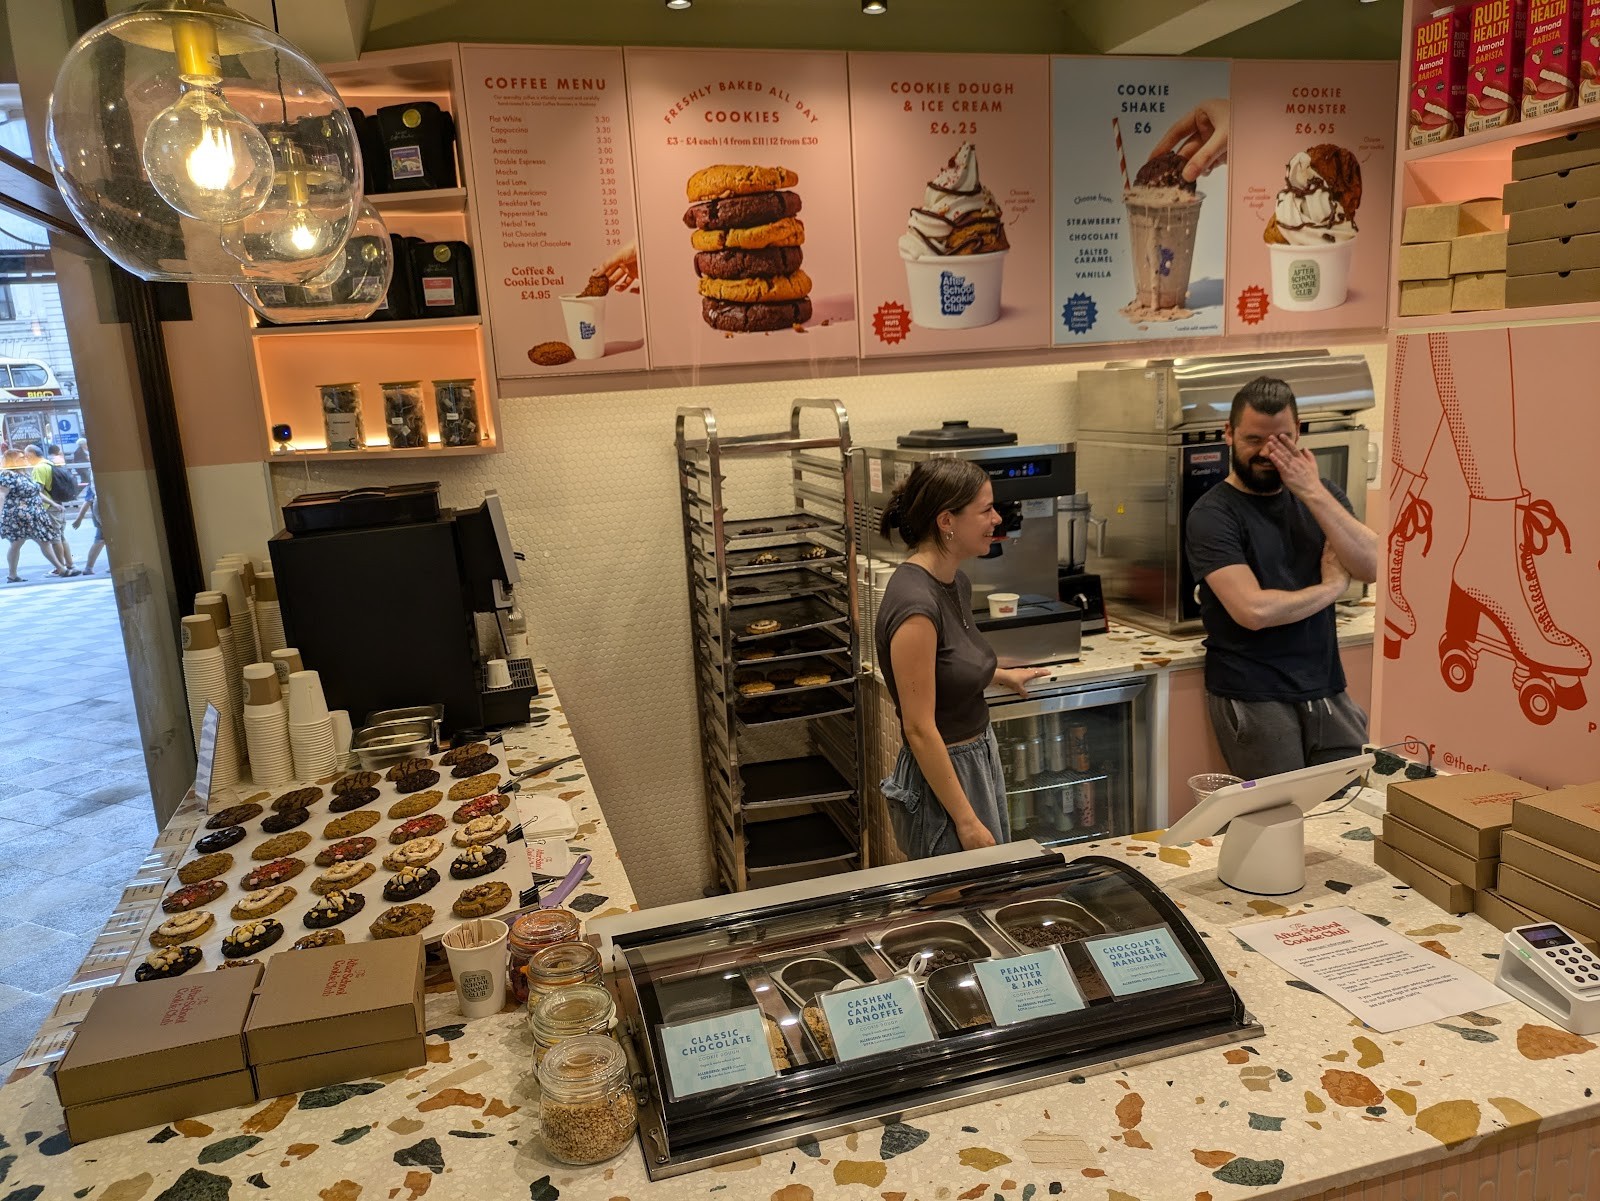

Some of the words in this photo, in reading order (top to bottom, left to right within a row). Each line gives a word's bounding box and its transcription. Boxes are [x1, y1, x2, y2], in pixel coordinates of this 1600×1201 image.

[1474, 0, 1510, 28] RUDE
[1531, 0, 1566, 24] HEALTH
[1417, 18, 1448, 46] RUDE
[1474, 19, 1509, 43] HEALTH
[1533, 20, 1562, 35] Almond
[1532, 31, 1560, 46] BARISTA
[1416, 40, 1448, 61] HEALTH
[1477, 38, 1504, 54] Almond
[1475, 49, 1503, 64] BARISTA
[1419, 58, 1443, 71] Almond
[1418, 68, 1442, 82] BARISTA
[485, 78, 547, 89] COFFEE
[558, 79, 606, 90] MENU
[891, 82, 950, 94] COOKIE
[958, 83, 1014, 94] DOUGH
[1118, 85, 1169, 96] COOKIE
[1292, 88, 1342, 98] COOKIE
[664, 85, 712, 124] FRESHLY
[719, 80, 762, 92] BAKED
[769, 87, 790, 103] ALL
[796, 101, 818, 124] DAY
[904, 101, 912, 112] &
[922, 101, 944, 112] ICE
[952, 101, 1002, 112] CREAM
[1122, 102, 1166, 112] SHAKE
[1286, 104, 1346, 114] MONSTER
[705, 111, 780, 123] COOKIES
[931, 122, 977, 134] £6.25
[1135, 122, 1151, 134] £6
[1296, 123, 1335, 134] £6.95
[667, 137, 678, 145] £3
[686, 137, 697, 145] £4
[802, 137, 818, 145] £30
[1074, 195, 1097, 204] Choose
[512, 267, 544, 275] Coffee
[547, 266, 554, 275] &
[504, 276, 541, 286] Cookie
[542, 276, 564, 285] Deal
[943, 276, 965, 286] After
[943, 283, 974, 294] School
[521, 291, 550, 299] £4.95
[944, 293, 975, 304] Cookie
[944, 302, 966, 312] Club
[1274, 931, 1302, 940] After
[1301, 921, 1341, 933] School
[1283, 934, 1323, 945] Cookie
[1321, 928, 1349, 937] Club
[1103, 938, 1159, 953] CHOCOLATE
[1109, 947, 1150, 960] ORANGE
[1112, 952, 1166, 966] MANDARIN
[1000, 962, 1039, 974] PEANUT
[1005, 970, 1041, 982] BUTTER
[1022, 978, 1042, 988] JAM
[847, 992, 891, 1008] CASHEW
[847, 1000, 897, 1016] CARAMEL
[848, 1007, 902, 1025] BANOFFEE
[691, 1029, 738, 1044] CLASSIC
[682, 1035, 750, 1055] CHOCOLATE
